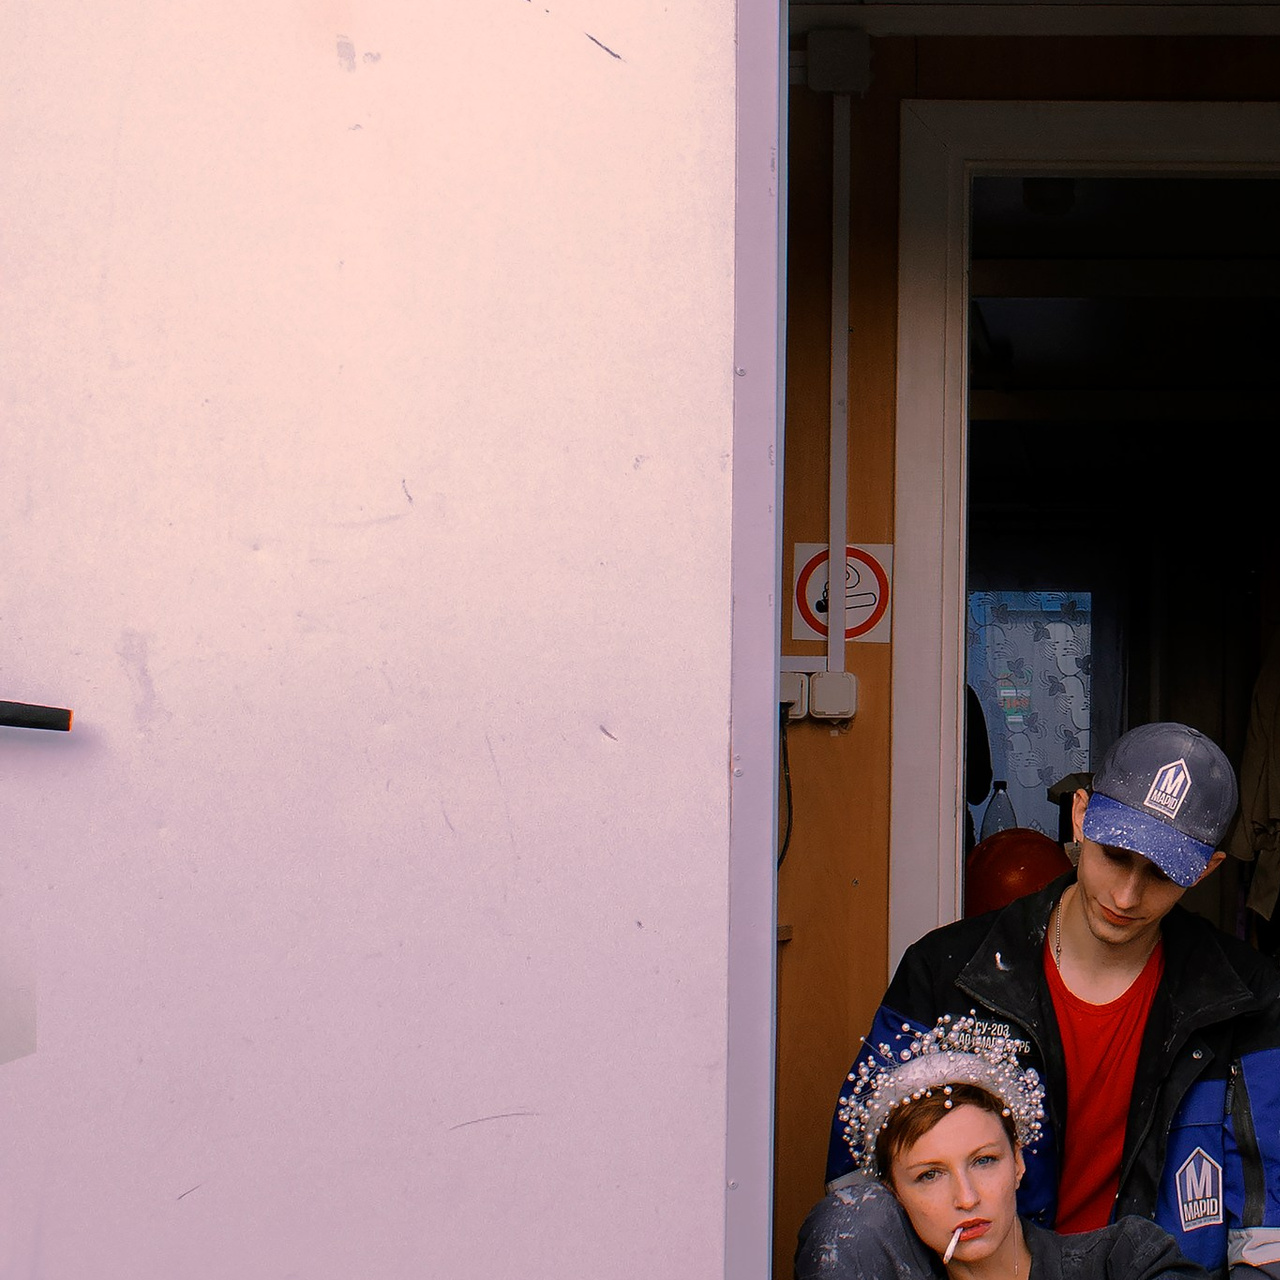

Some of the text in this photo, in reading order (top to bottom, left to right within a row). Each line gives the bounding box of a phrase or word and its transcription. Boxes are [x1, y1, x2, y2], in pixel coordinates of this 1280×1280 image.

[1151, 789, 1179, 809] MAPID
[1186, 1159, 1212, 1201] M
[1183, 1198, 1219, 1222] MAPID
